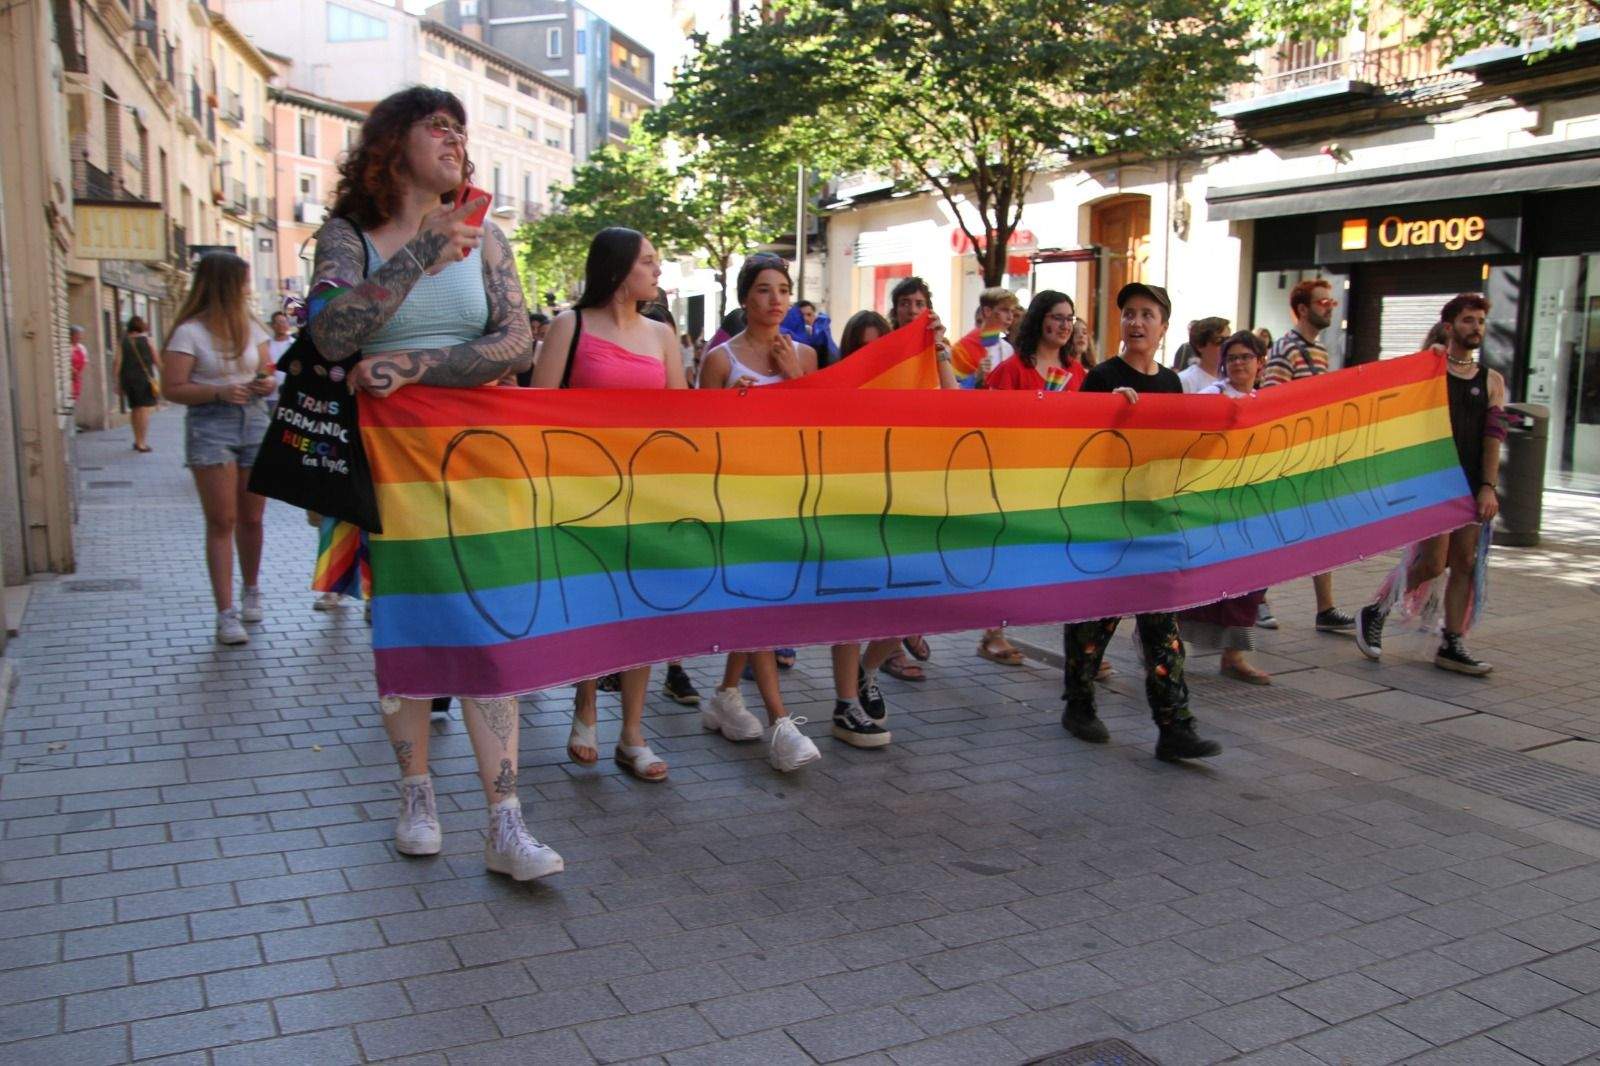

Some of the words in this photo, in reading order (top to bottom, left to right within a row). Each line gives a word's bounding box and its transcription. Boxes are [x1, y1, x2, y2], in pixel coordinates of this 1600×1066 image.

[1379, 216, 1485, 251] Orange
[297, 391, 340, 415] TRANS
[441, 428, 1006, 639] ORGULLO
[1056, 429, 1134, 574] O
[1173, 392, 1417, 560] BARBARIE
